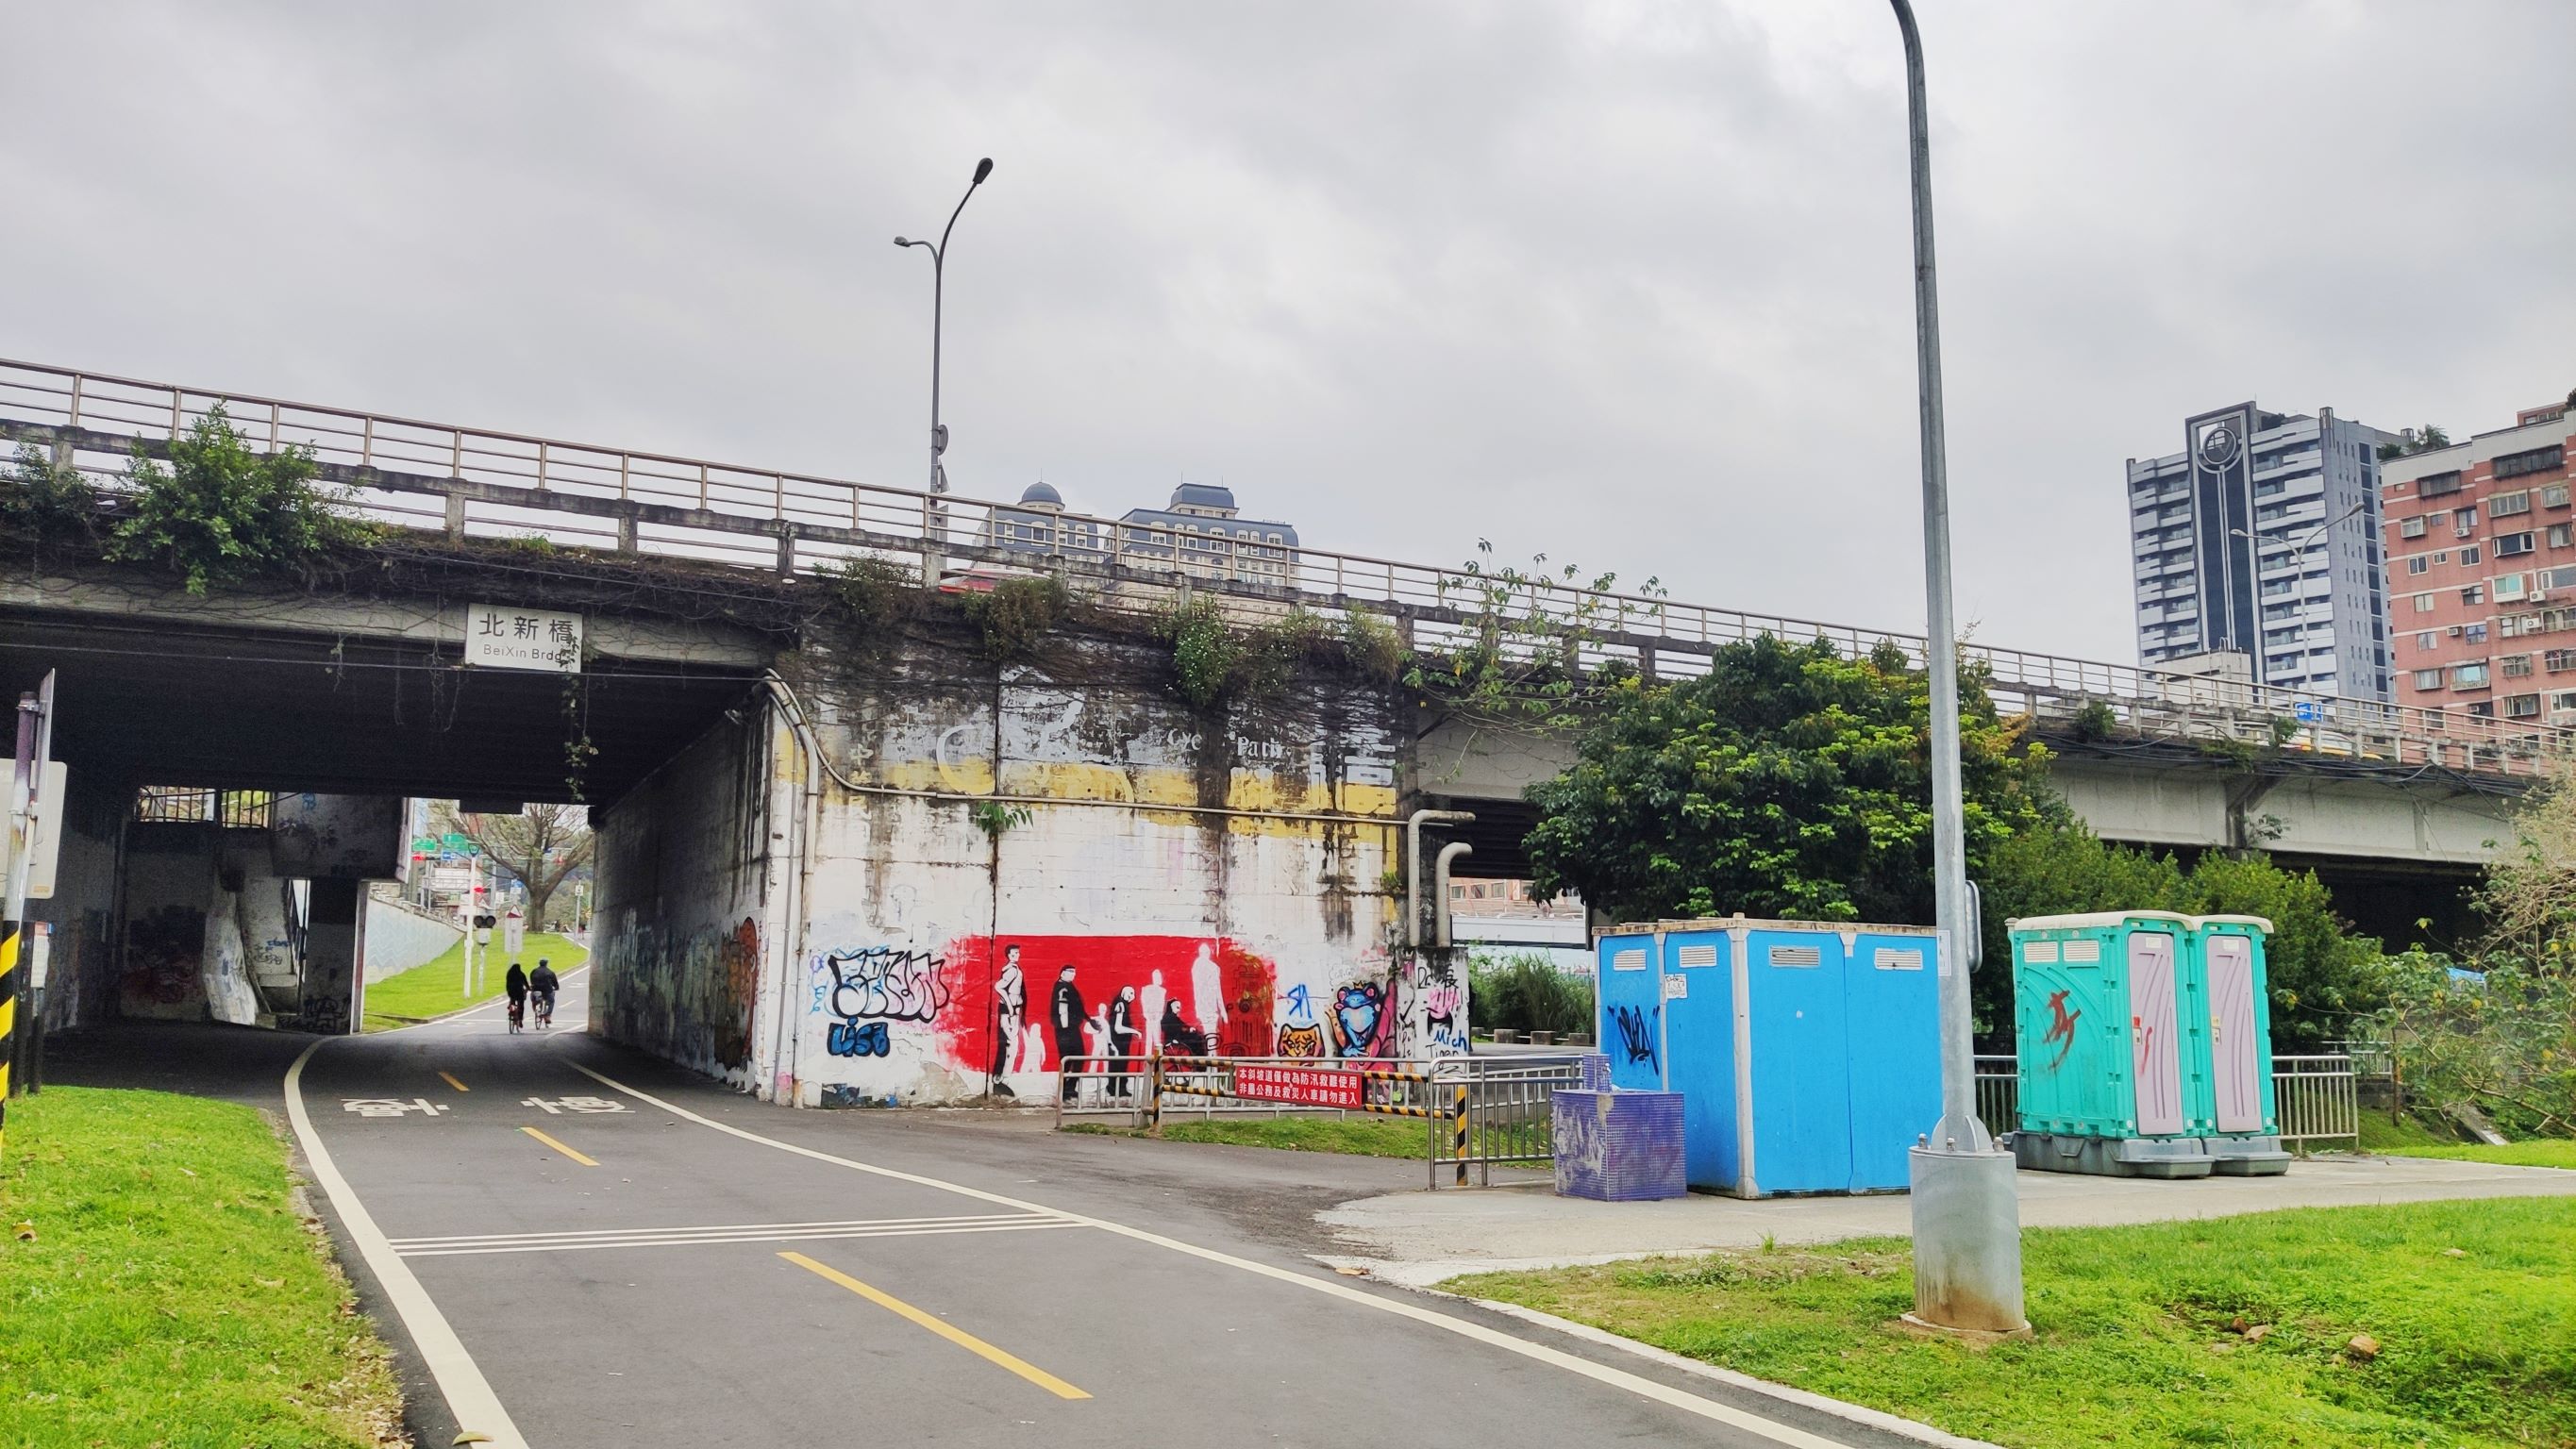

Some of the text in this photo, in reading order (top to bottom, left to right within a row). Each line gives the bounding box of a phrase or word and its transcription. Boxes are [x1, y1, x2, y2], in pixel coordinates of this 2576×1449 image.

[478, 612, 574, 643] 北新橋
[483, 643, 527, 658] BeiXin
[520, 1096, 636, 1114] 慢
